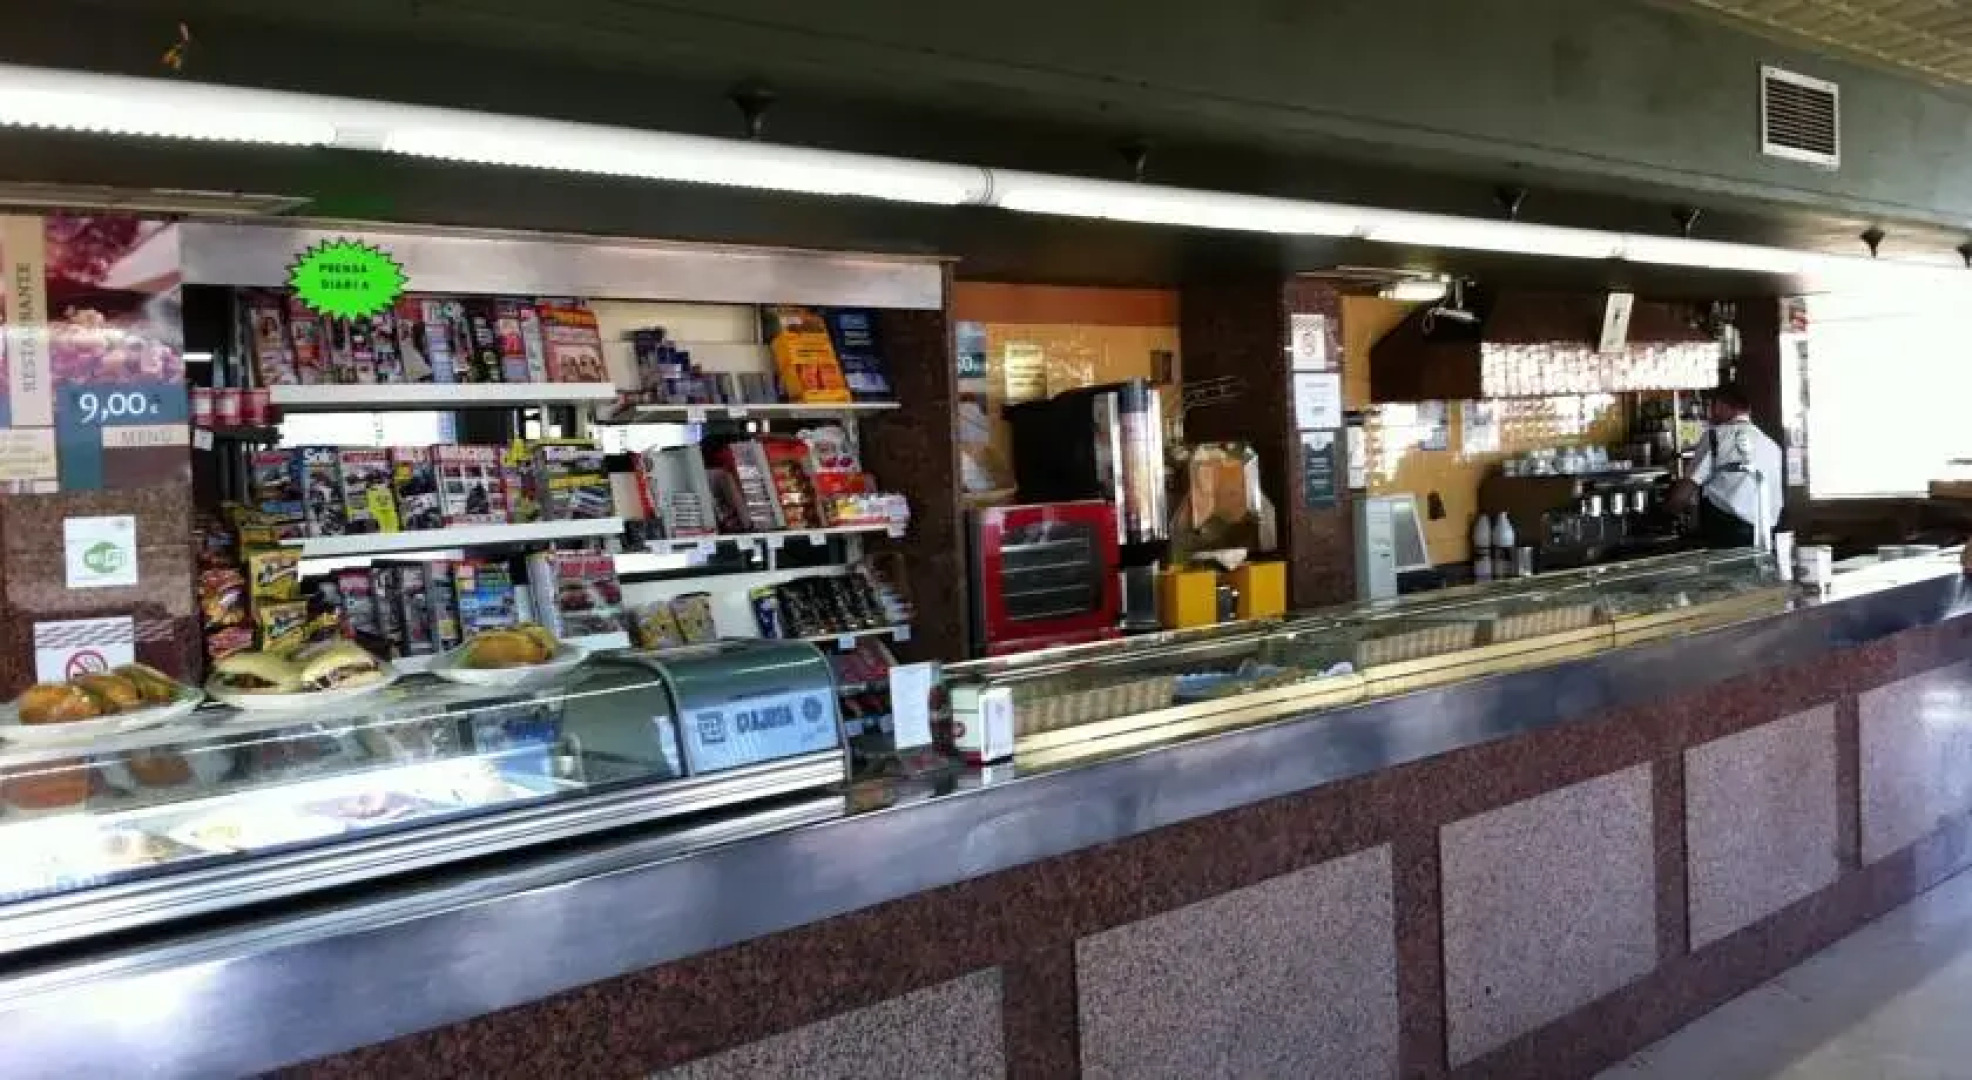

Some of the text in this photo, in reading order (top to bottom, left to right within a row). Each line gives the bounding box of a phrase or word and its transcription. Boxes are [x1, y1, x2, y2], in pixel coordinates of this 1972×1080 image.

[318, 263, 368, 274] PRENSA
[320, 279, 370, 291] DIARIA
[16, 262, 37, 393] RESTARANTE
